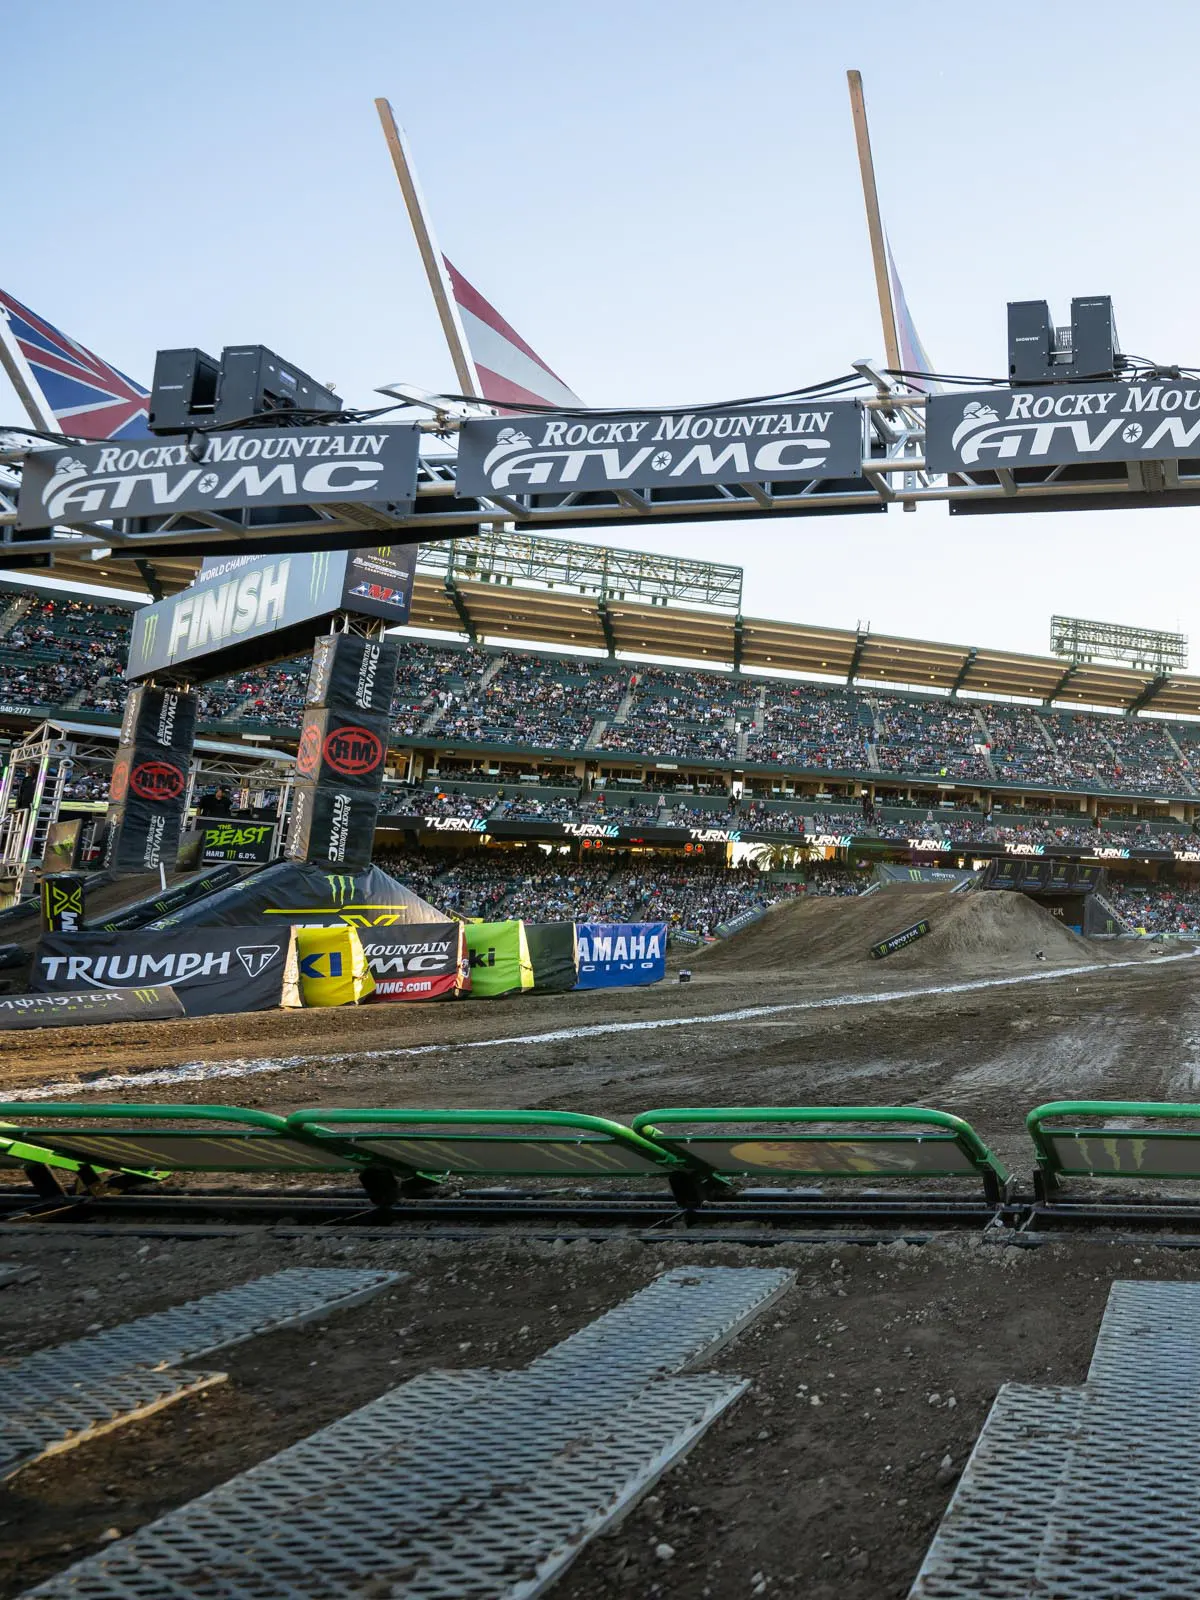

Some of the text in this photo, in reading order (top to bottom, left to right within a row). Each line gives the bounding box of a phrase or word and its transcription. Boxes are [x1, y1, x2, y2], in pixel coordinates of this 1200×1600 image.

[1004, 393, 1117, 420] ROCKY
[538, 411, 835, 447] ROCKY MOUNTAIN
[962, 416, 1126, 465] ATV
[201, 434, 390, 463] MOUNTAIN
[492, 438, 831, 490] ATV MC
[48, 461, 384, 520] ATV MC
[200, 564, 225, 583] WORLD
[348, 581, 406, 608] AMA
[167, 558, 291, 657] FINISH
[356, 643, 371, 698] ROCKY MOUNTAIN
[368, 645, 380, 675] MC
[337, 805, 351, 862] ROCKY MOUNTAIN
[424, 817, 488, 832] TURN14
[562, 823, 620, 838] TURN14
[689, 829, 741, 842] TURN14
[205, 826, 271, 848] BEAST
[328, 830, 339, 862] MC
[804, 834, 852, 847] TURN14
[908, 839, 951, 851] TURN14
[1004, 843, 1045, 855] TURN14
[205, 850, 225, 858] HARD
[364, 941, 451, 956] MOUNTAIN
[888, 929, 918, 948] MONSTER
[41, 951, 231, 981] TRIUMPH
[0, 993, 125, 1010] MONSTER
[17, 1003, 108, 1014] ENERGY
